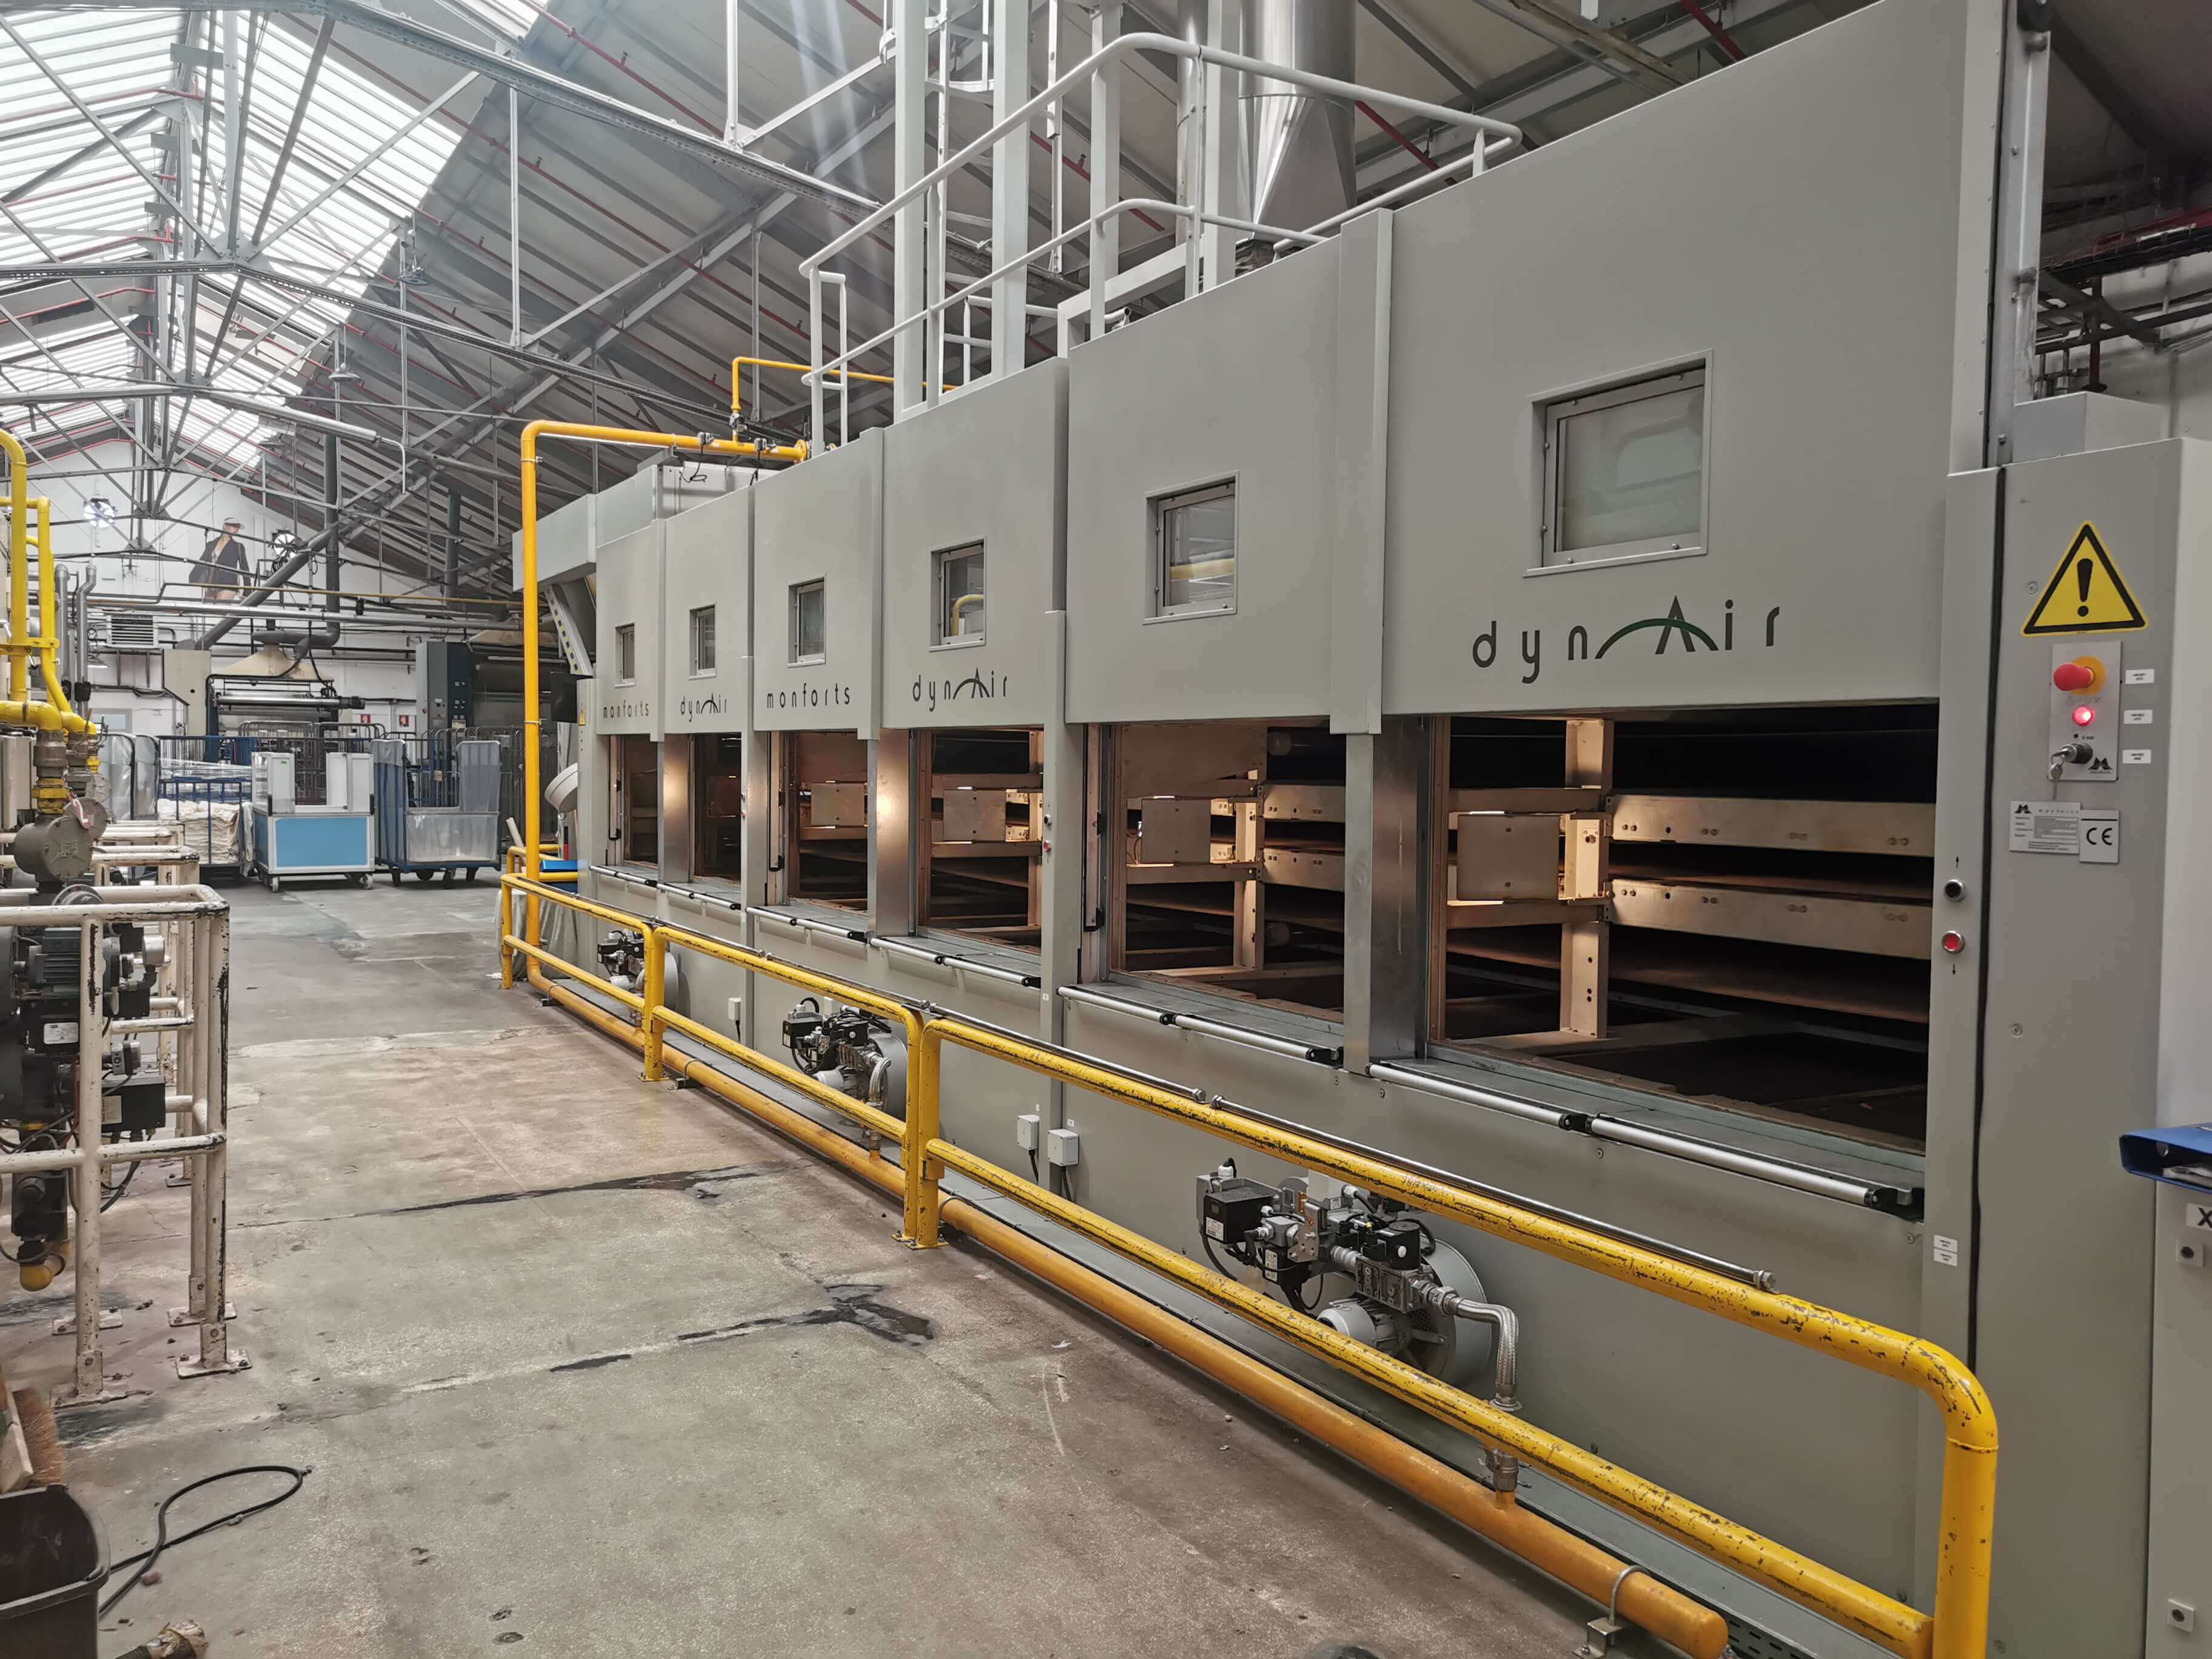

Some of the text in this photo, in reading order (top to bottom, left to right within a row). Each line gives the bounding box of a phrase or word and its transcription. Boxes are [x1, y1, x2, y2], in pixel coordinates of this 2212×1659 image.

[1472, 595, 1780, 684] dynAir
[766, 682, 850, 708] monforts
[912, 668, 1008, 712] dynAir
[603, 699, 649, 719] monforts
[680, 692, 728, 722] dynAir
[2086, 827, 2113, 846] CE
